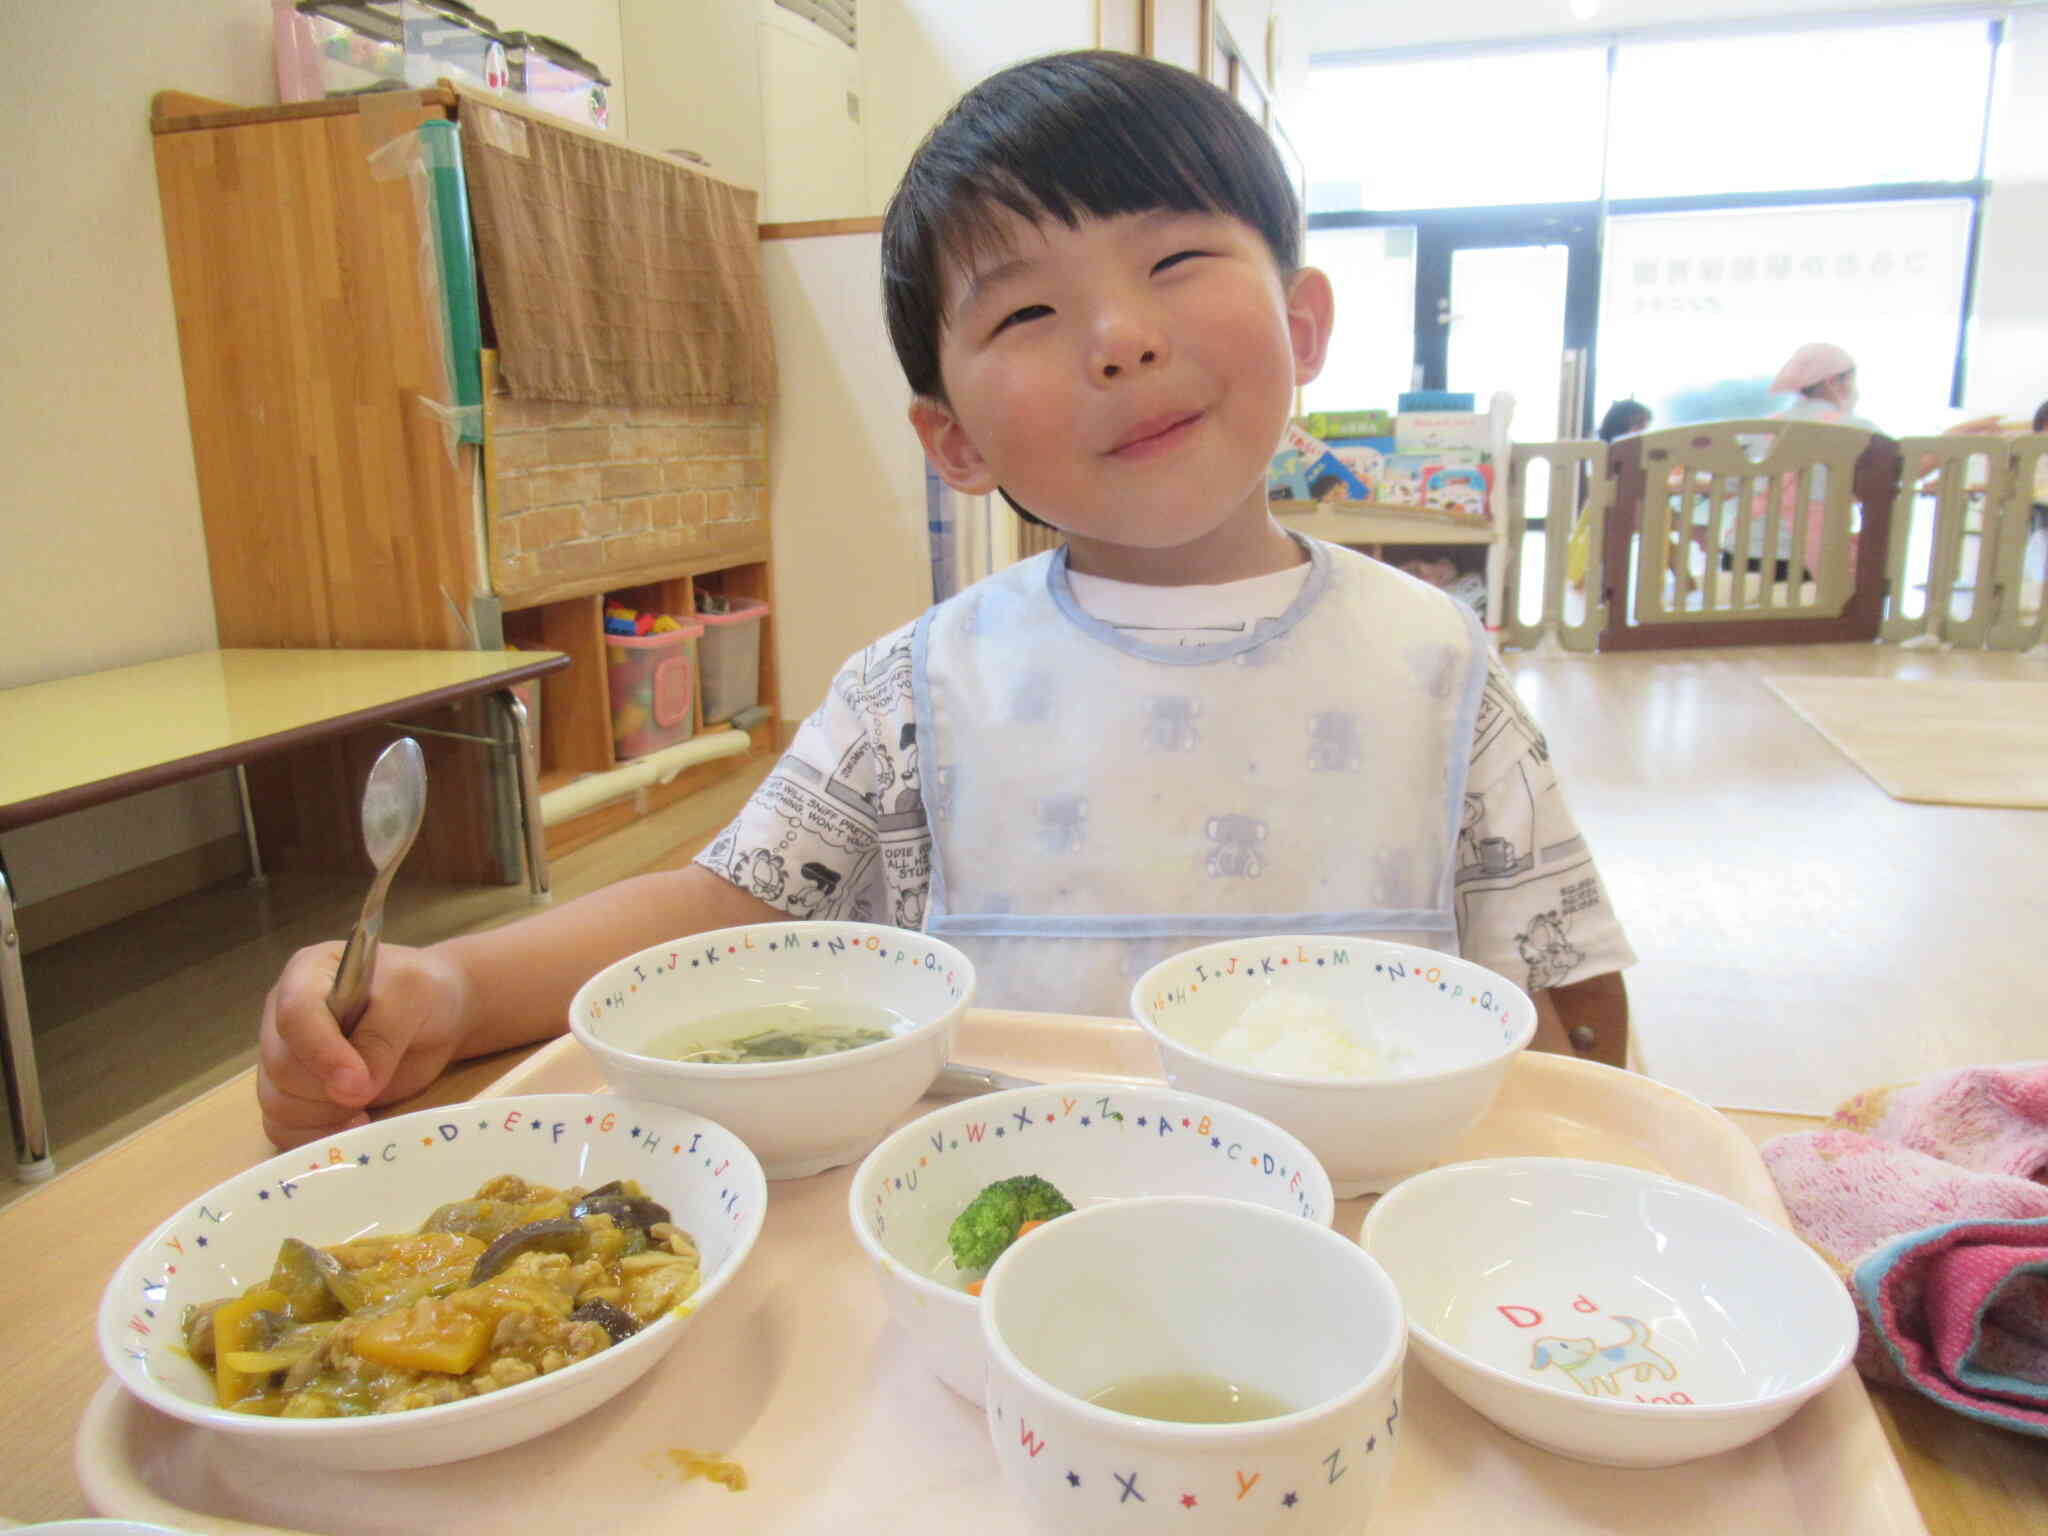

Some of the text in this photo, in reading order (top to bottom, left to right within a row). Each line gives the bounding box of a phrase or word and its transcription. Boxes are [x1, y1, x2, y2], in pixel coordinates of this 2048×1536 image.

[634, 964, 648, 984] I
[667, 952, 680, 972] J
[706, 947, 721, 966] K
[744, 933, 756, 951] L
[783, 932, 801, 951] M
[828, 936, 846, 955] N
[865, 934, 880, 952] O
[924, 952, 937, 972] Q
[1196, 965, 1209, 984] I
[1225, 956, 1240, 977] J
[1259, 956, 1276, 976] K
[1296, 945, 1309, 964] L
[1332, 948, 1351, 966] M
[1387, 961, 1407, 981] N
[1424, 966, 1442, 984] O
[1479, 990, 1494, 1011] Q
[165, 1235, 185, 1256] Y
[328, 1146, 344, 1165] B
[381, 1142, 397, 1162] C
[437, 1123, 459, 1142] D
[503, 1111, 523, 1132] E
[552, 1122, 567, 1144] F
[599, 1112, 617, 1133] G
[642, 1130, 661, 1153] H
[688, 1133, 702, 1154] I
[904, 1168, 919, 1192] U
[930, 1130, 944, 1153] V
[965, 1121, 987, 1143] W
[1012, 1106, 1033, 1132] X
[1159, 1115, 1174, 1137] A
[1197, 1114, 1213, 1136] B
[1226, 1142, 1243, 1161] C
[1262, 1152, 1275, 1176] D
[1496, 1305, 1543, 1329] D
[1021, 1415, 1046, 1458] W
[1113, 1471, 1145, 1504] X
[1236, 1470, 1262, 1501] Y
[1322, 1447, 1347, 1485] Z
